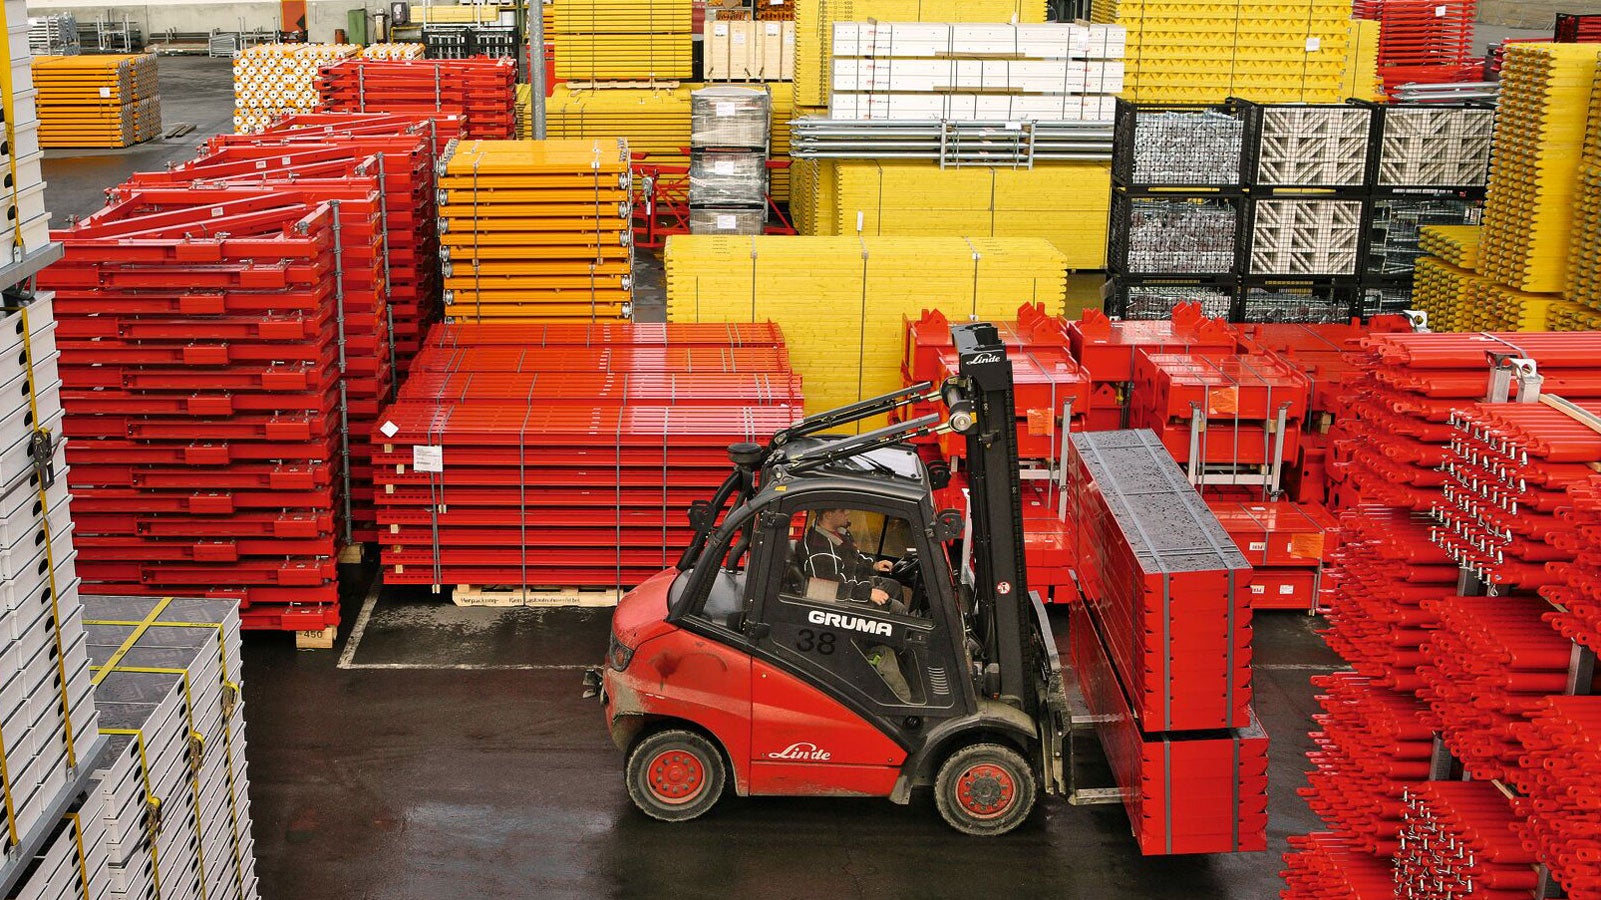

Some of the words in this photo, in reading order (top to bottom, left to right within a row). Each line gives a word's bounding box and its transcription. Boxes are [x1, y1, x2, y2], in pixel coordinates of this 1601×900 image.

[966, 352, 1001, 365] Linde
[808, 610, 893, 637] GRUMA
[303, 630, 323, 639] 450
[796, 628, 836, 655] 38
[768, 742, 831, 761] Linde
